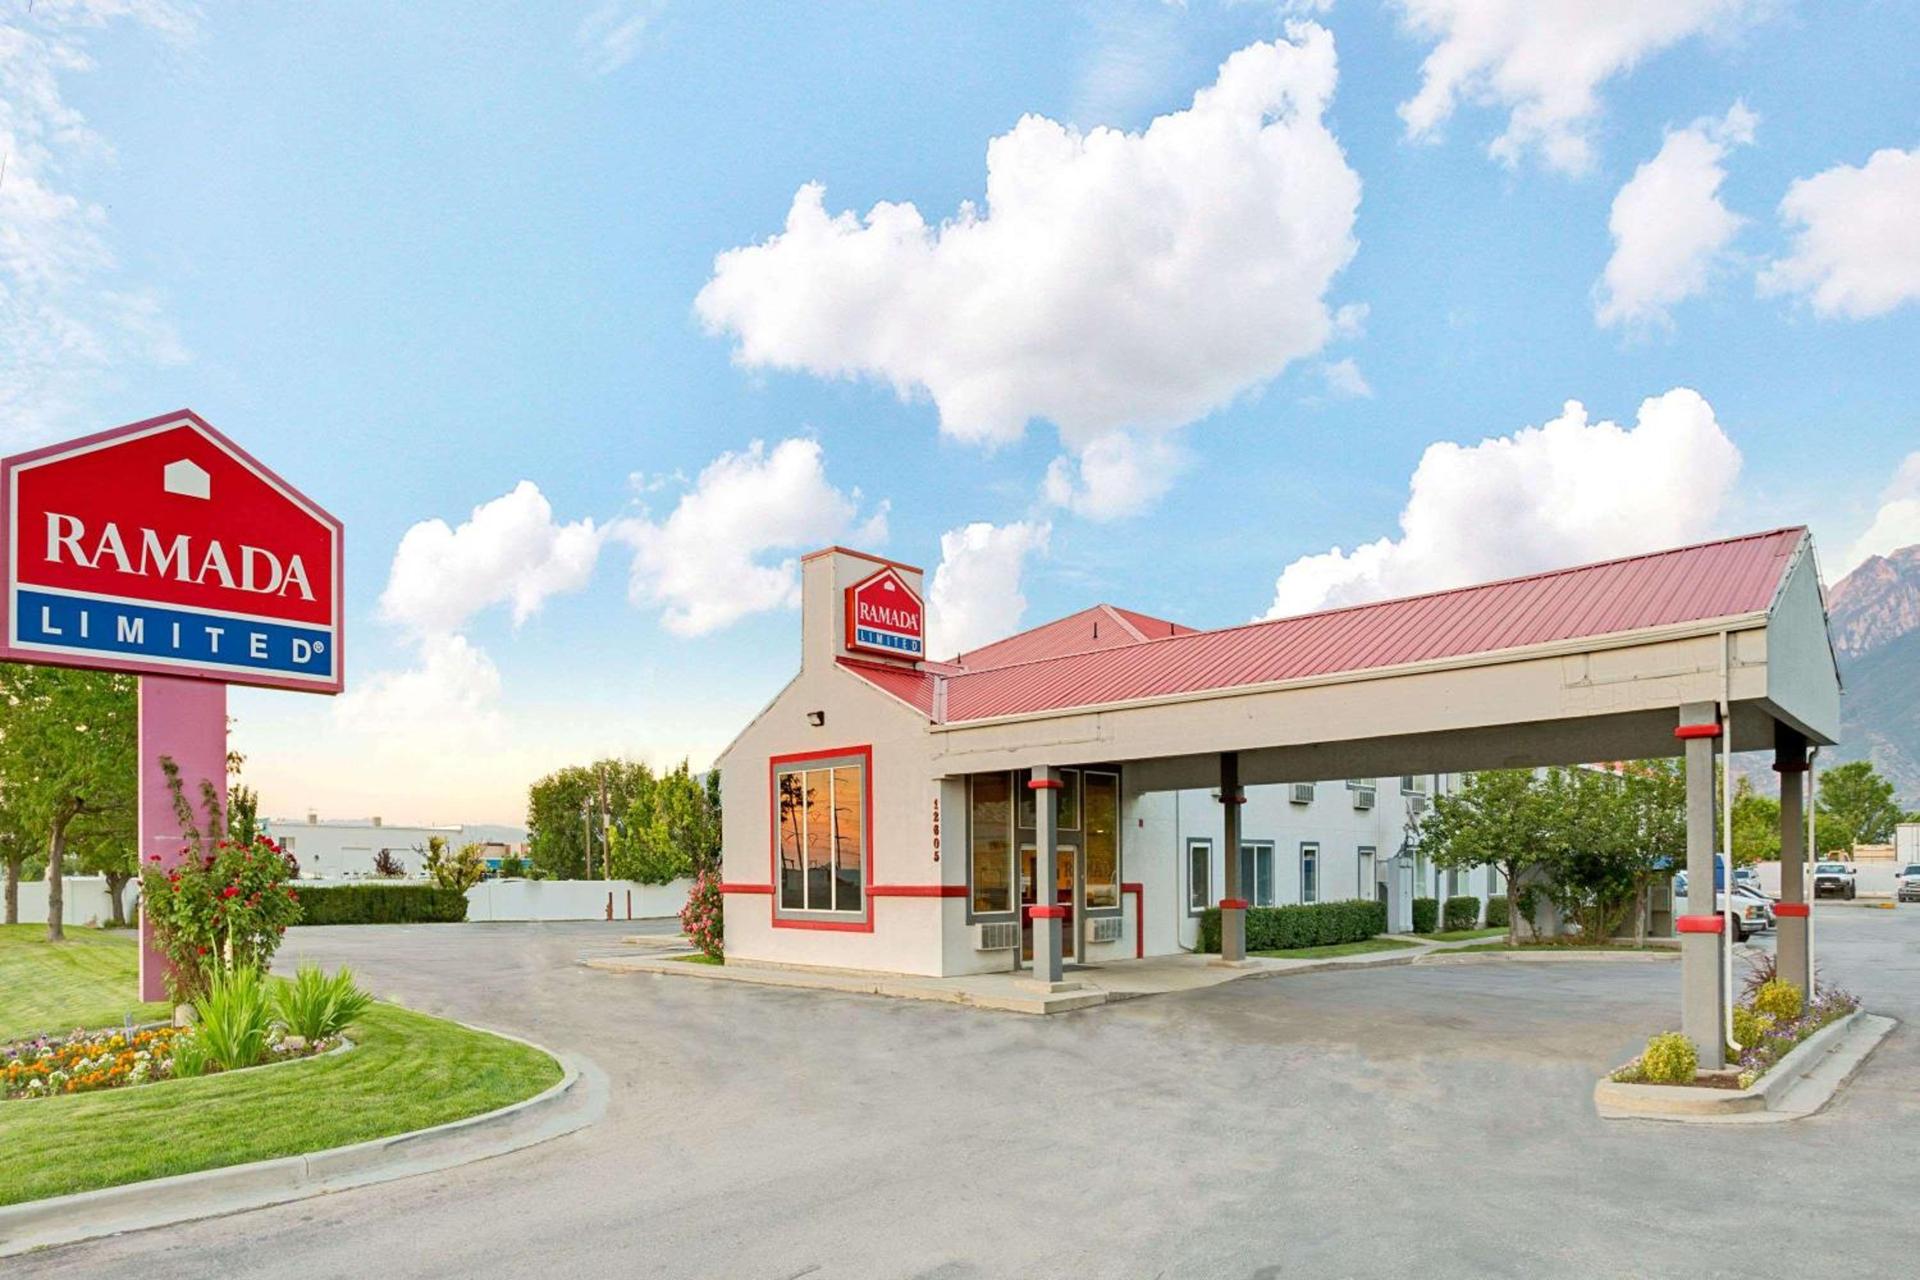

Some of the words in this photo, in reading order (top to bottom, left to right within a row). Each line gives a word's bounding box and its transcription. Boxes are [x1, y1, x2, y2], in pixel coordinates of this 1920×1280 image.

[43, 511, 317, 602] RAMADA
[860, 602, 918, 630] RAMADA
[860, 630, 918, 651] LIMITED
